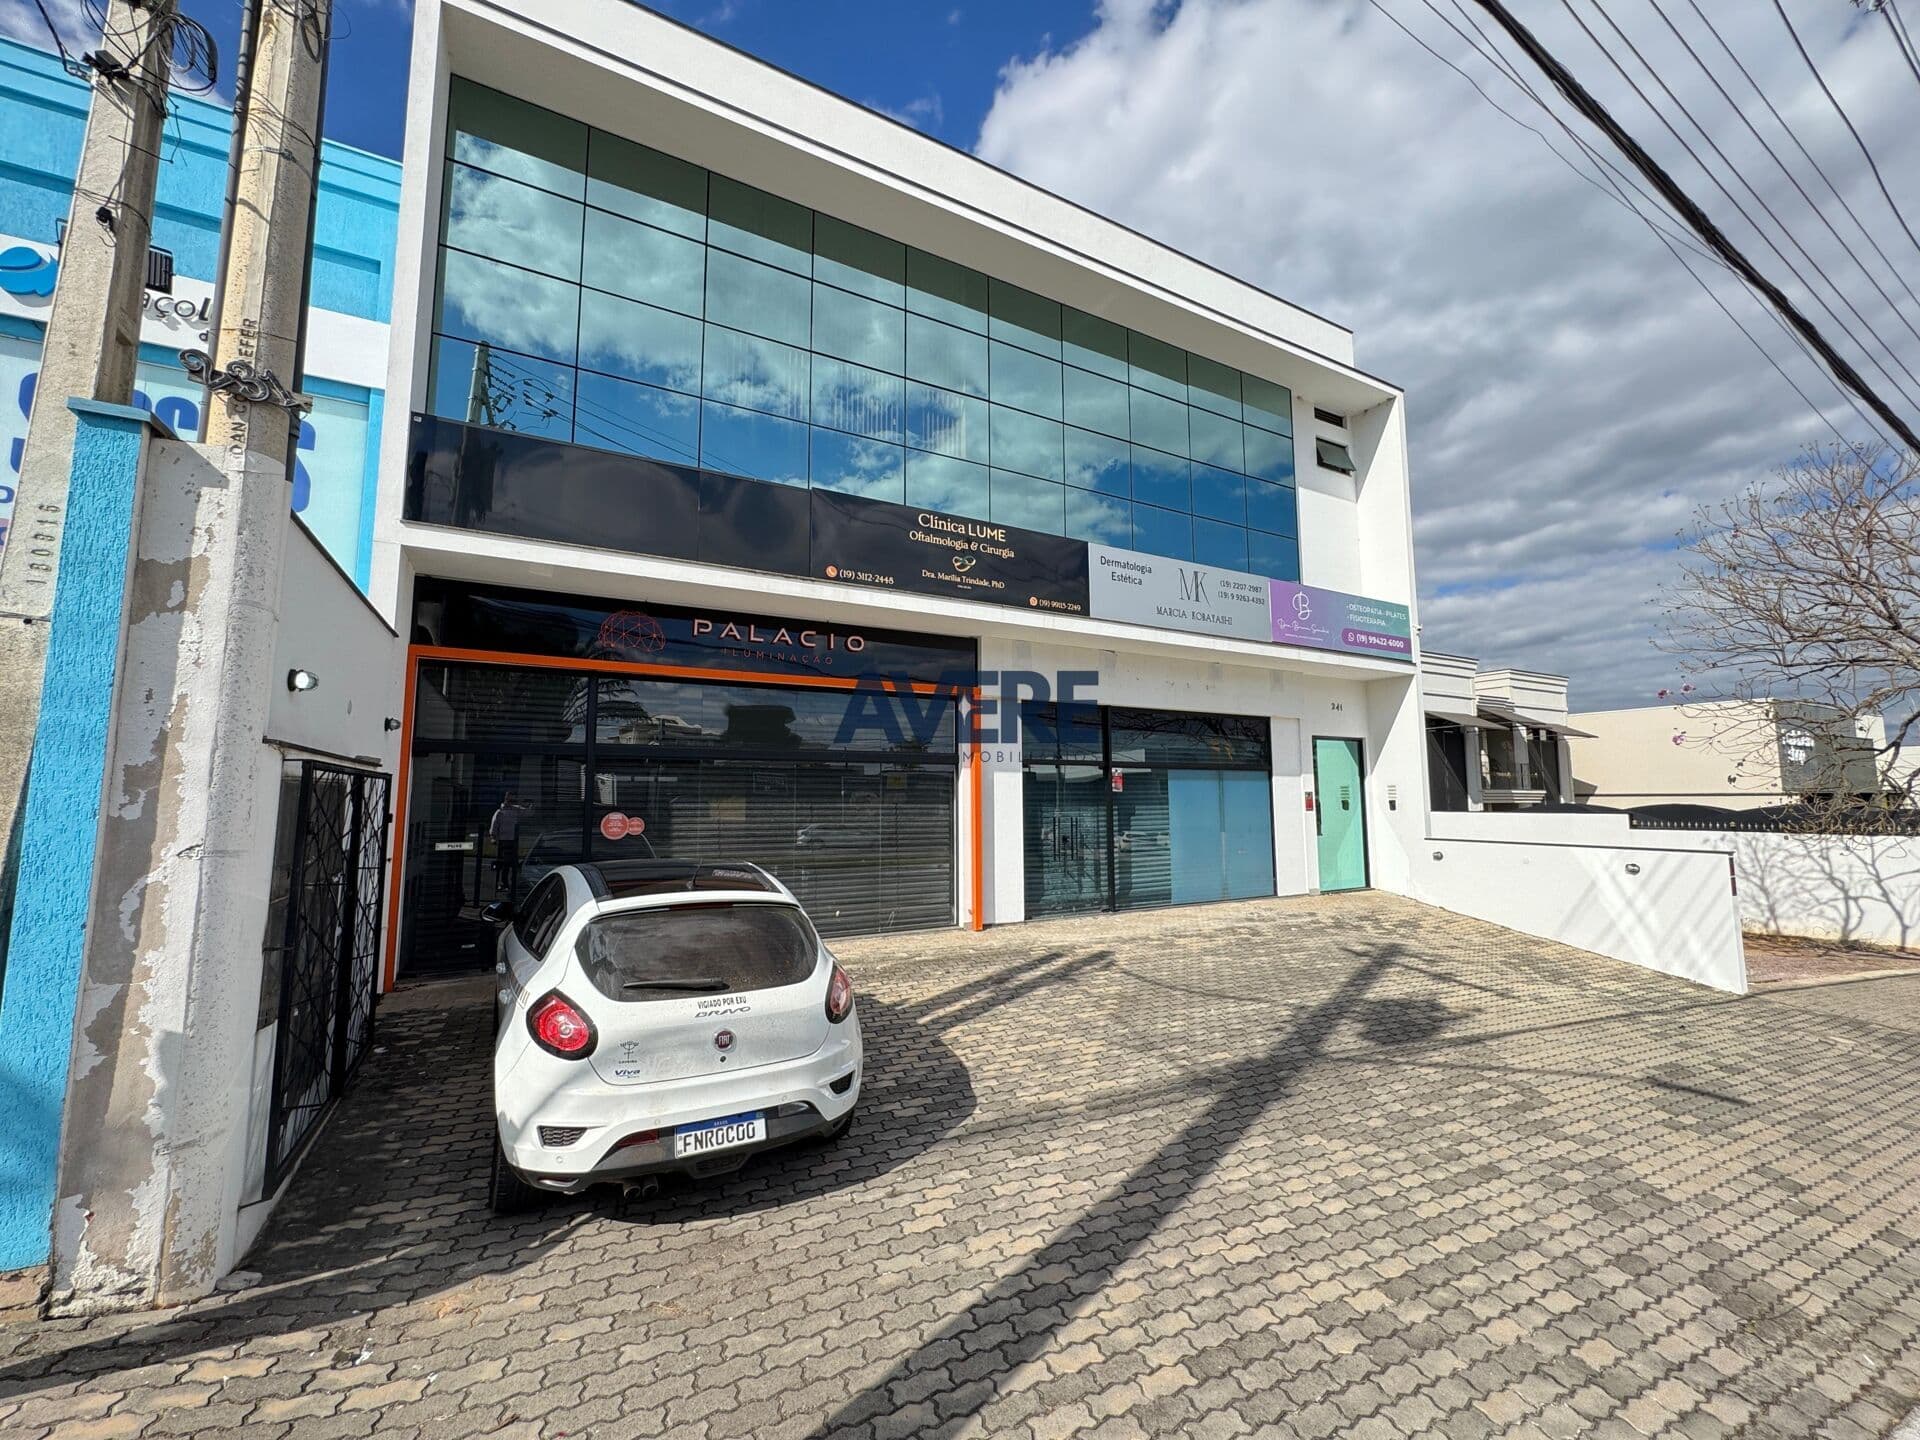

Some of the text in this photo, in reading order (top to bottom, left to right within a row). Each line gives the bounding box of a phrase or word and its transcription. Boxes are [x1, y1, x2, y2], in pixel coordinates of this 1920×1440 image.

[918, 513, 1006, 542] Clínica LUME
[909, 530, 1015, 558] Oftalmologia & Cirurgia
[839, 569, 855, 580] (19)
[1100, 555, 1152, 575] Dermatologia
[922, 569, 936, 579] Dra.
[991, 580, 1005, 589] PhD
[1111, 571, 1143, 586] Estética
[1178, 567, 1211, 608] MK
[692, 618, 866, 652] PALACIO
[1330, 702, 1344, 712] 241
[697, 999, 721, 1009] VIGIADO
[722, 997, 734, 1006] POR
